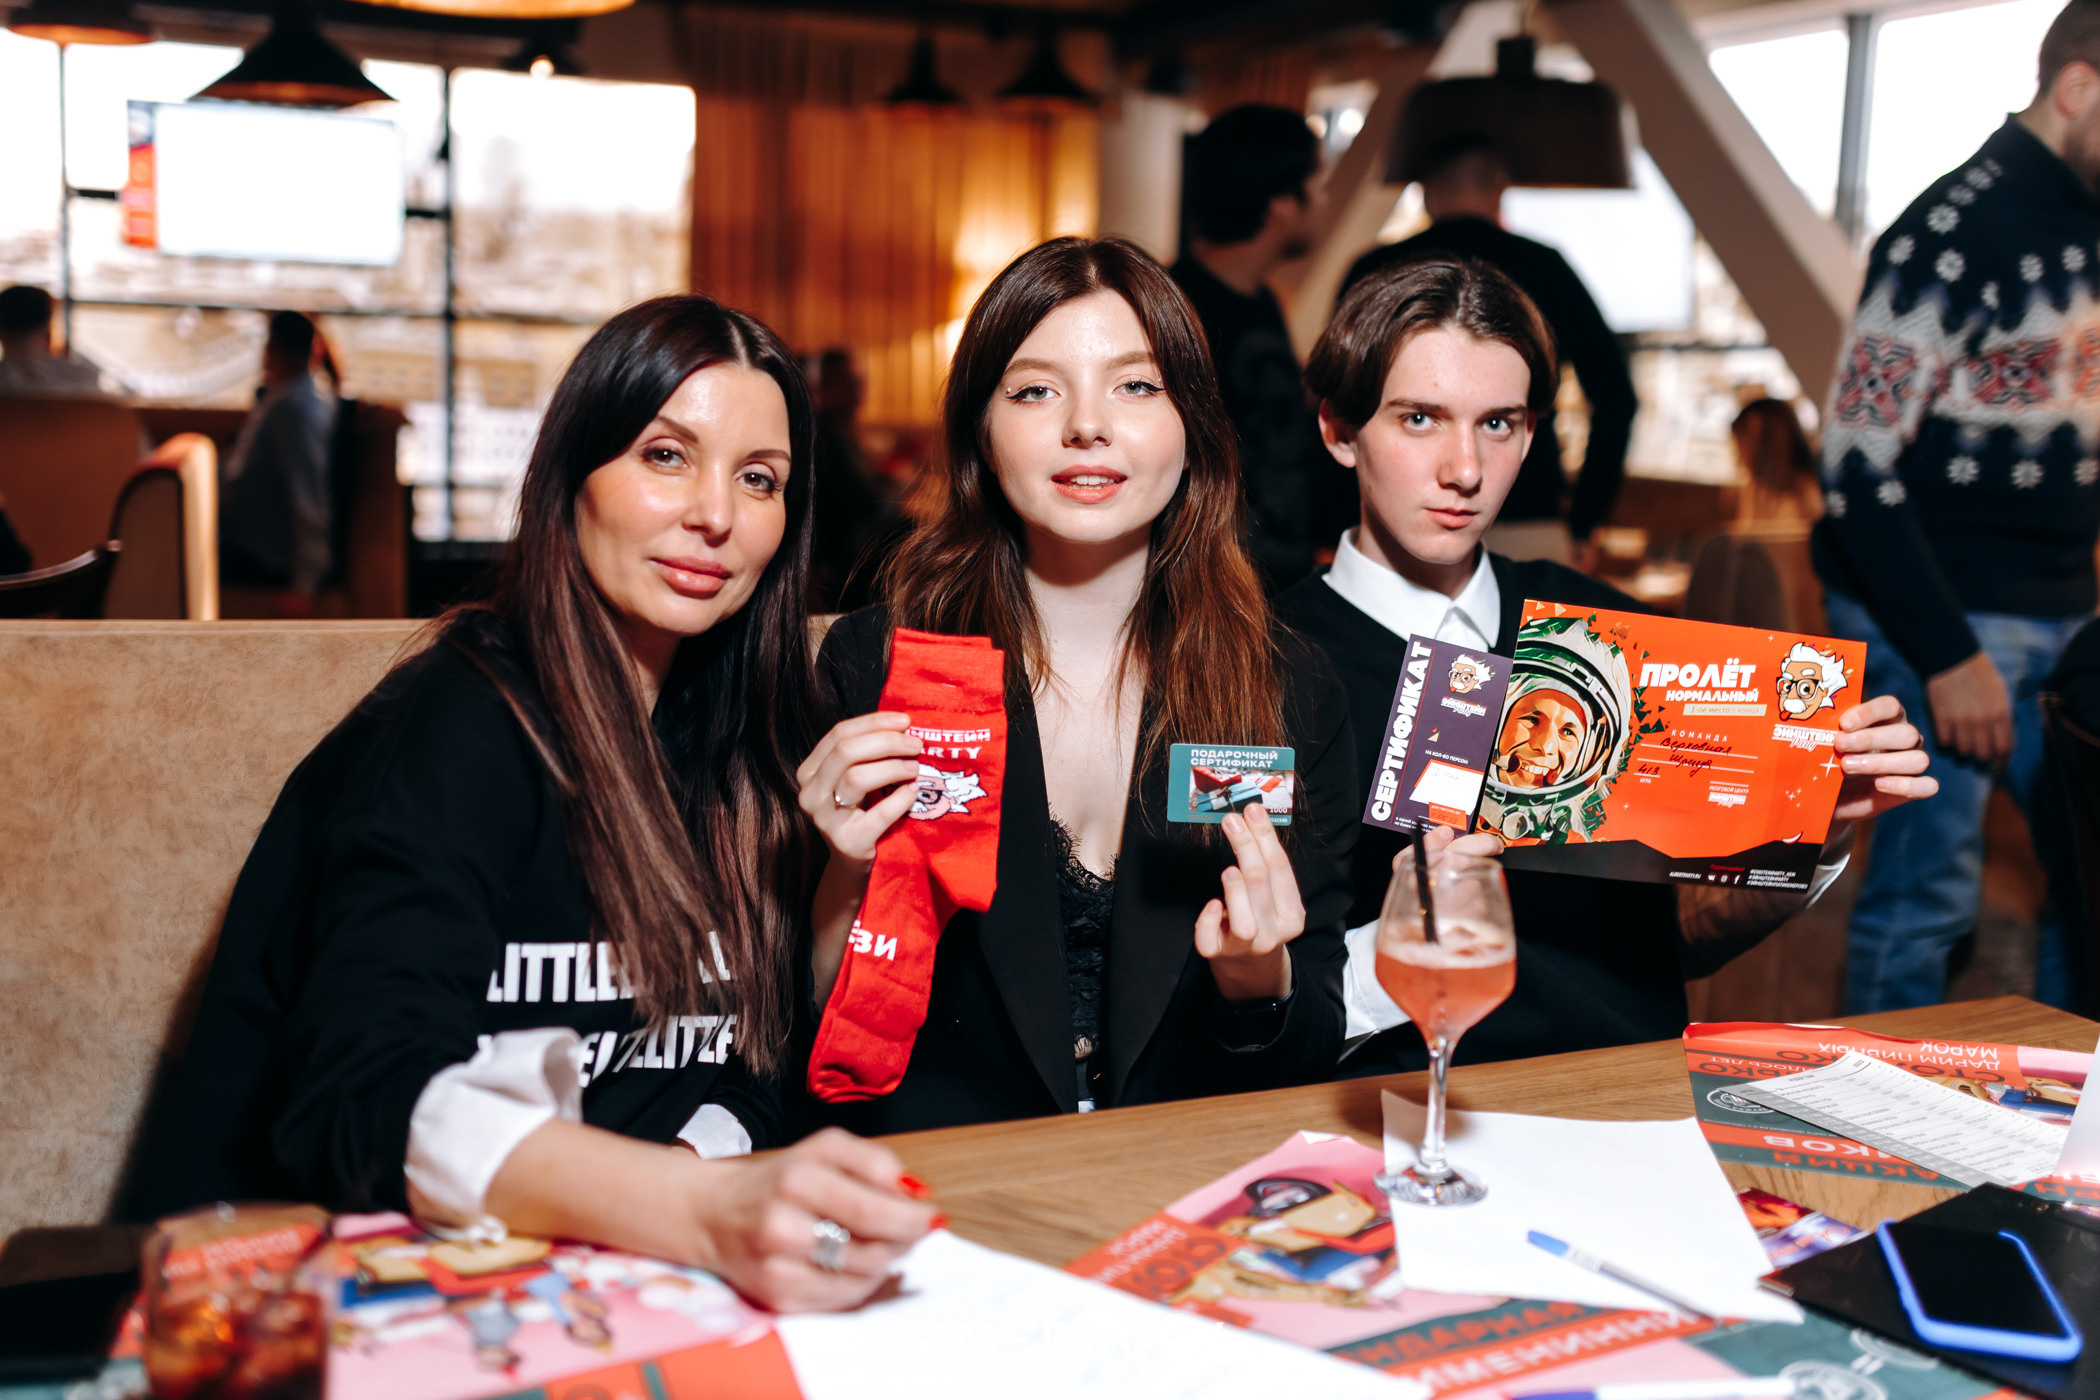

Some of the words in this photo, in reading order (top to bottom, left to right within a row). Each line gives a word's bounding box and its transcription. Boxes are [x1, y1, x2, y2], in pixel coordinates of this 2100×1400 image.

[1639, 658, 1756, 687] ПРОЛЁТ
[1666, 688, 1759, 702] НОРМАЛЬНЫЙ
[1371, 641, 1432, 821] СЕРТИФИКАТ
[1671, 730, 1728, 742] КОМАНДА
[1190, 757, 1273, 768] СЕРТИФИКАТ
[1191, 749, 1278, 760] ПОДАРОЧНЫЙ
[1920, 1041, 1998, 1060] МАРОК
[1919, 1054, 2001, 1072] ДАРИМ
[1773, 1152, 1940, 1181] АКЦИЯ
